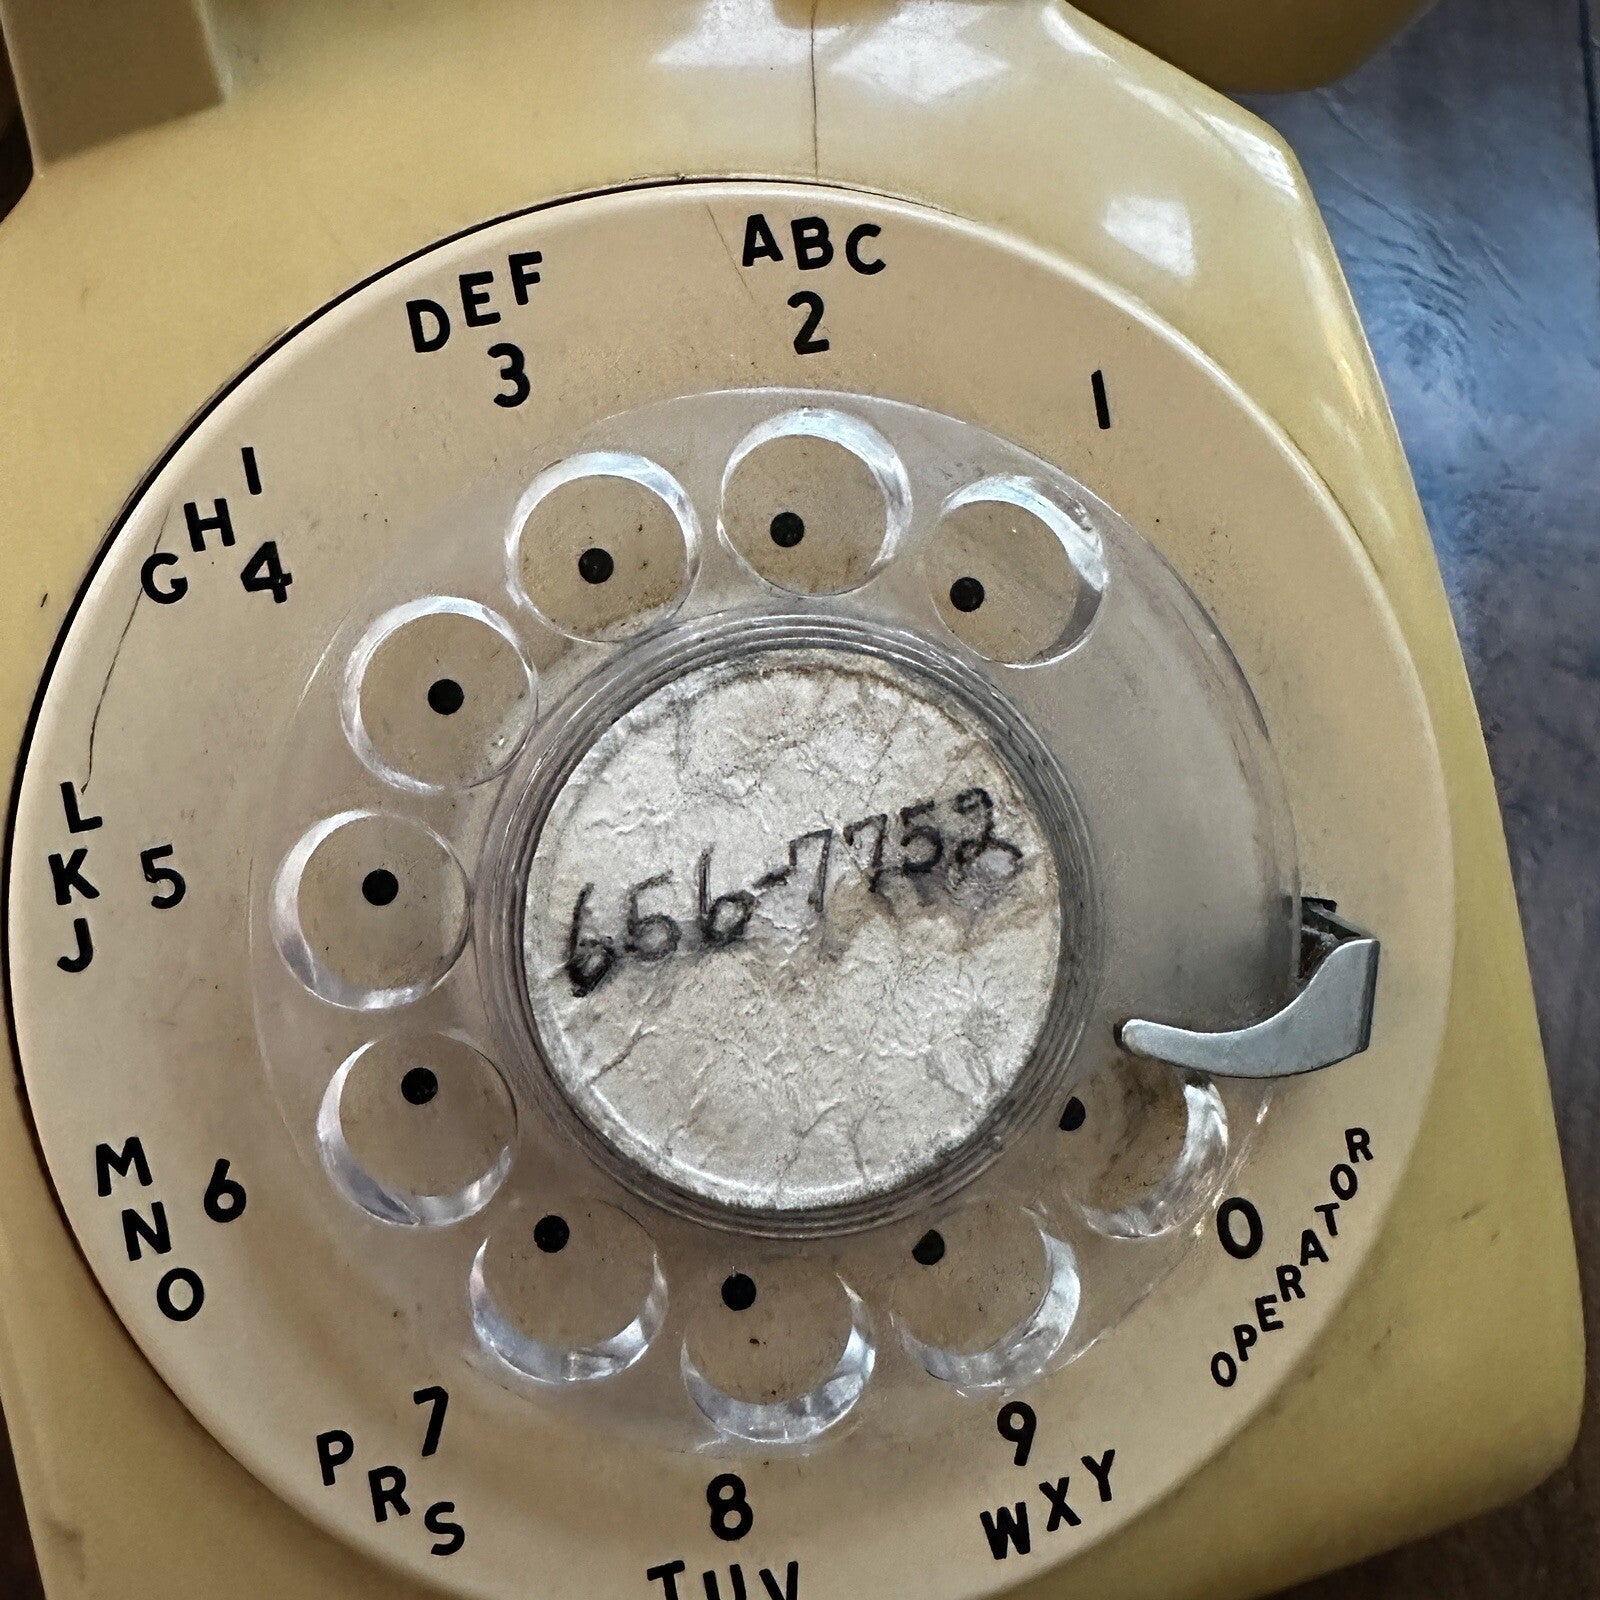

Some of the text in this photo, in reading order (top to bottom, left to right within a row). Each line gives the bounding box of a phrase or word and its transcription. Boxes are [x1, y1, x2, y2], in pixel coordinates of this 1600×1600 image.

[742, 213, 887, 276] ABC
[405, 250, 543, 354] DEF
[787, 290, 830, 356] 2
[487, 342, 531, 408] 3
[136, 446, 263, 606] GHI
[240, 540, 293, 604] 4
[139, 843, 187, 910] 5
[203, 1158, 247, 1224] 6
[95, 1136, 205, 1322] MNO
[1210, 1127, 1374, 1388] OPERATOR
[412, 1385, 450, 1458] 7
[996, 1400, 1037, 1467] 9
[315, 1429, 466, 1557] PRS
[705, 1473, 754, 1542] 8
[979, 1448, 1116, 1561] WXY
[647, 1559, 799, 1600] TUV
